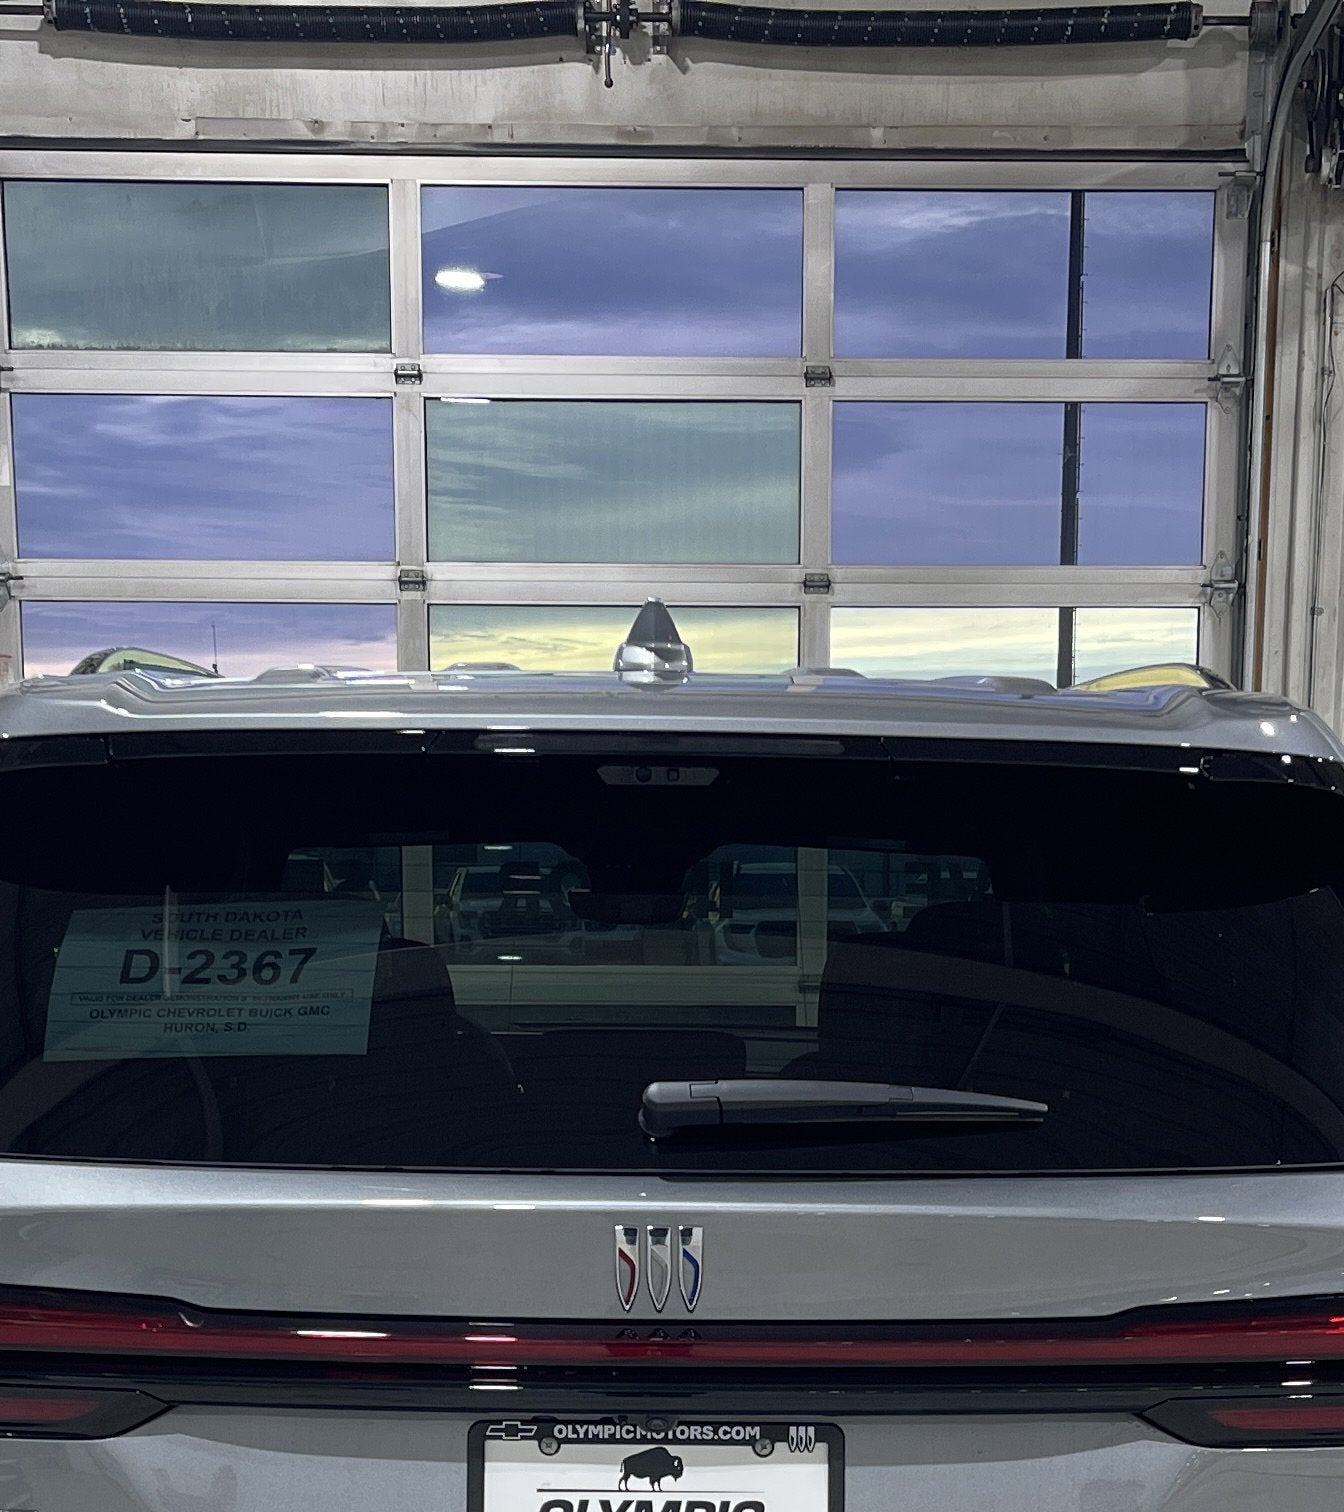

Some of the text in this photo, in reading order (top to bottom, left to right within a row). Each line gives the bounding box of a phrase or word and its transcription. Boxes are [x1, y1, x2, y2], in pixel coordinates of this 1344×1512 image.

[223, 909, 305, 924] DAKOTA
[229, 926, 308, 942] DEALER
[119, 946, 318, 986] D-2367
[88, 1004, 331, 1020] OLYMPIC CHEVROLET BUICK GMC
[163, 1021, 219, 1034] HURON,
